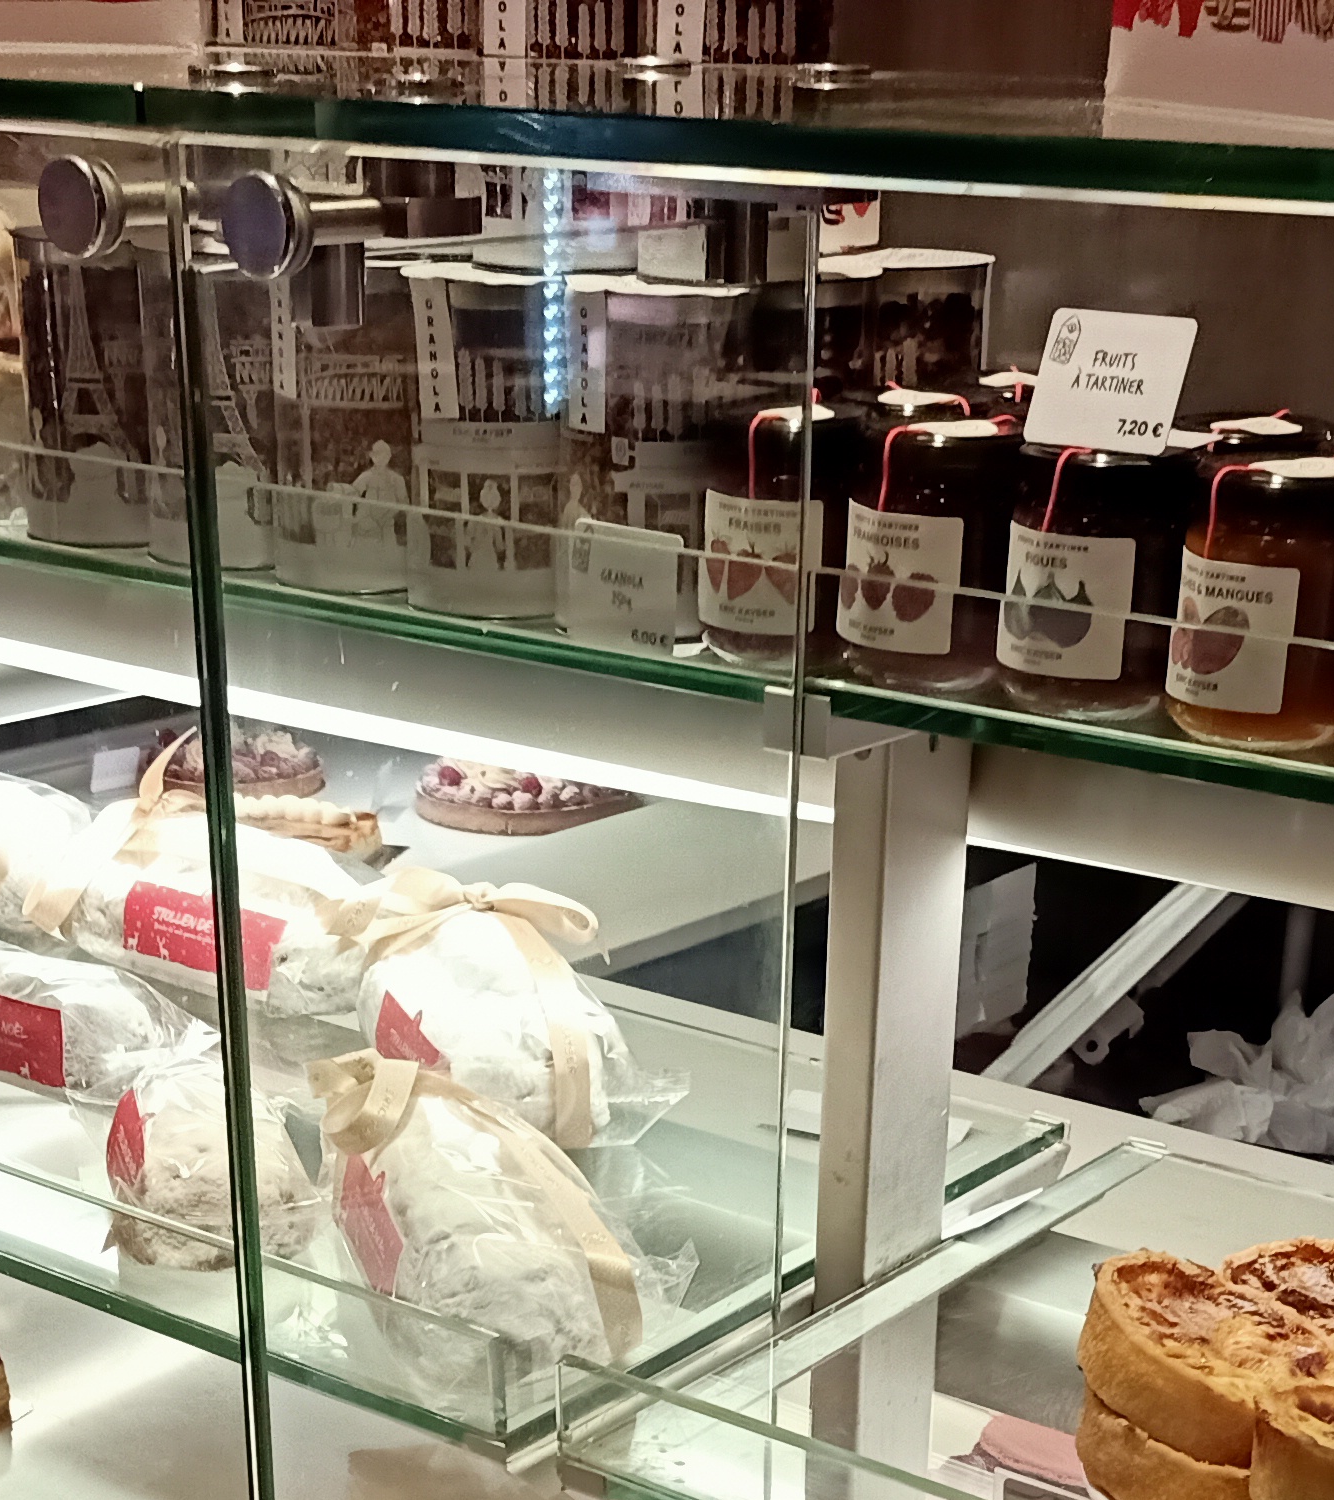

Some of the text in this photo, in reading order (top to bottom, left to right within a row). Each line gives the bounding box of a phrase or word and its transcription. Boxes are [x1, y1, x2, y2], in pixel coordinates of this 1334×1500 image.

[425, 298, 442, 413] GRANOLA
[579, 307, 589, 425] GRANOLA
[1092, 350, 1138, 371] FRUITS
[1086, 373, 1144, 395] TARTINER
[1117, 418, 1164, 438] 7,20 €
[728, 517, 782, 536] FRAISES
[853, 526, 920, 550] FRAMBOISES
[1025, 551, 1067, 569] FIGUES
[601, 568, 644, 590] GRANOLA
[1205, 586, 1274, 605] MANGUES
[152, 906, 195, 929] STOLLEN
[196, 918, 214, 933] DE
[1, 1021, 28, 1039] NOËL
